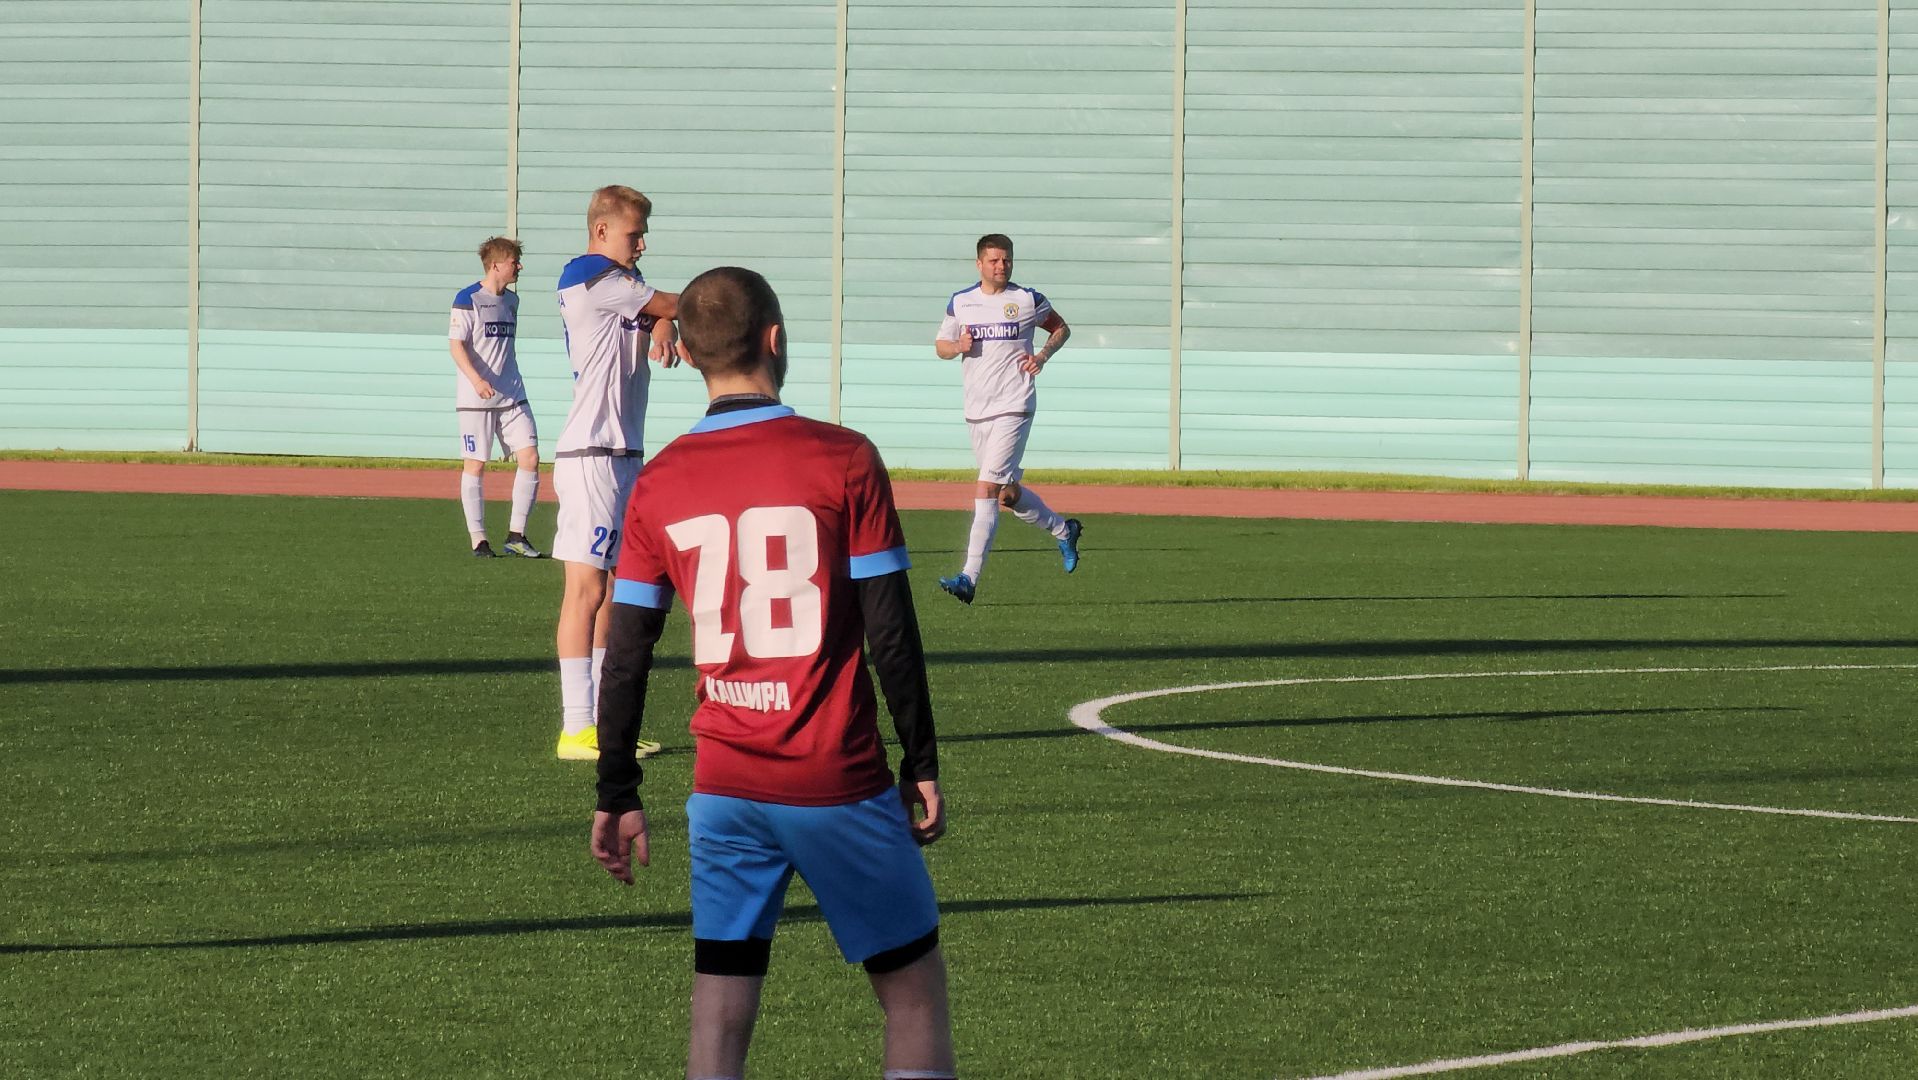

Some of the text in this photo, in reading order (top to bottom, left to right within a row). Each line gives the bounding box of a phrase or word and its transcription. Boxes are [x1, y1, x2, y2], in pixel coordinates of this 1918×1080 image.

[970, 324, 1018, 339] ОЛОМНА
[463, 433, 476, 453] 15
[590, 526, 618, 560] 22
[706, 675, 791, 713] КАШИРА
